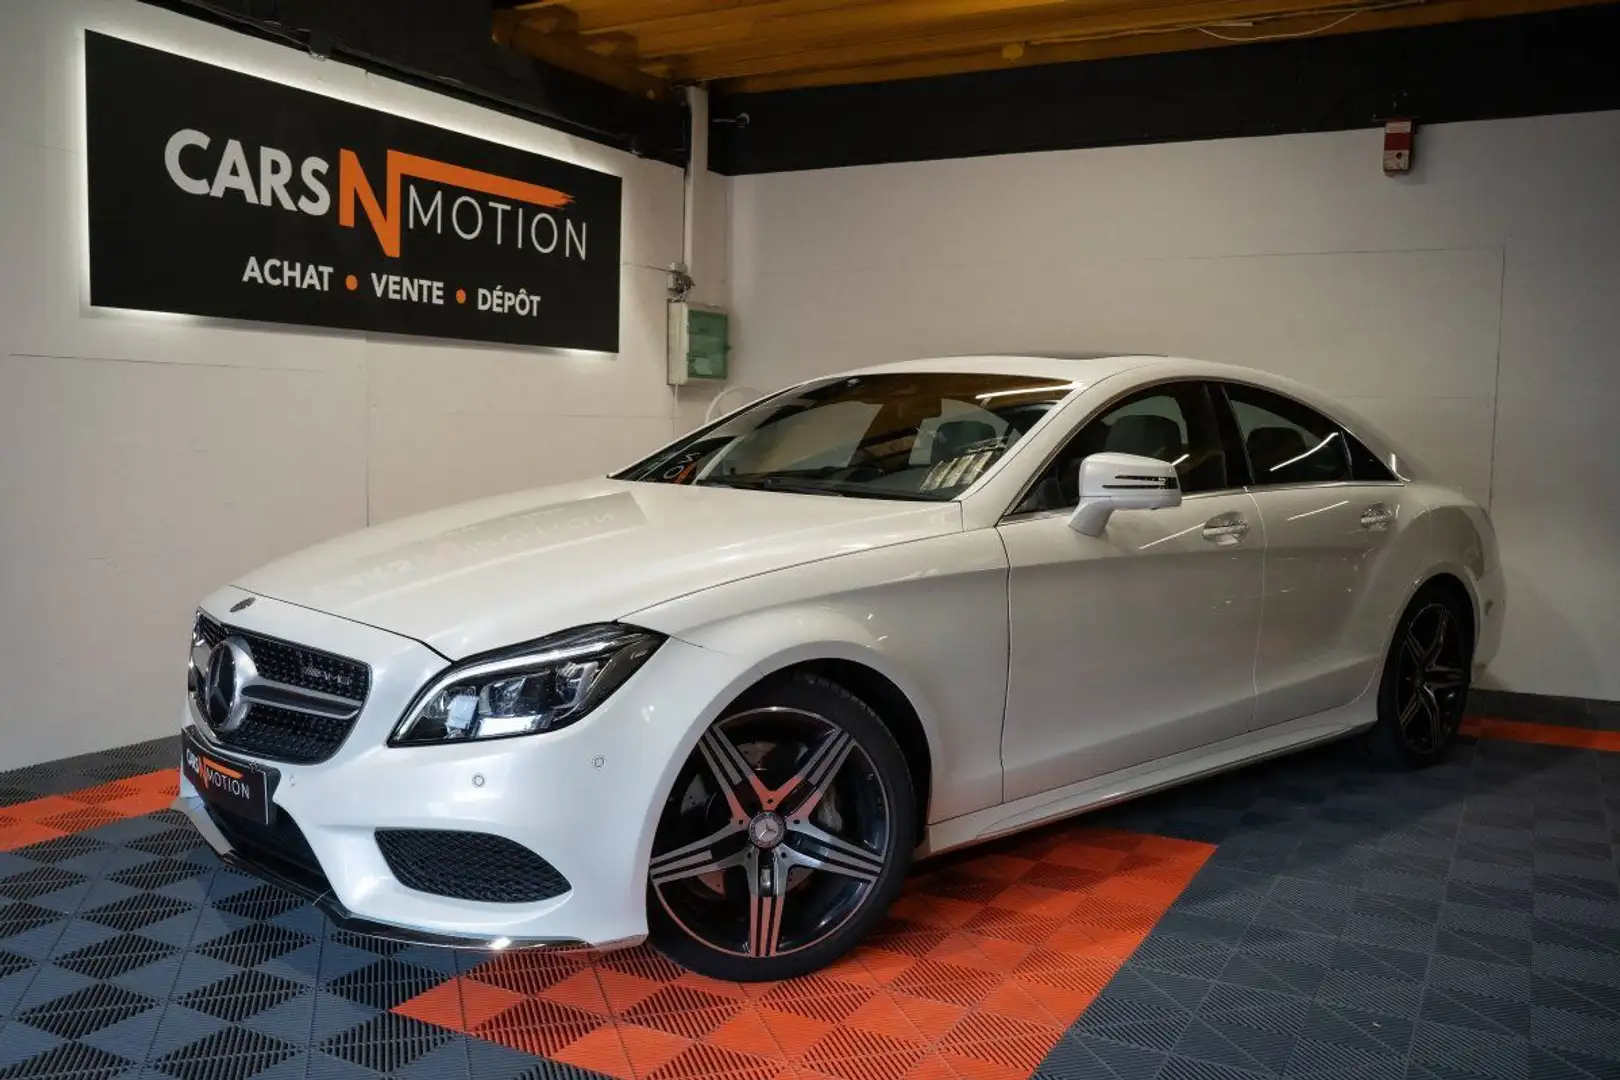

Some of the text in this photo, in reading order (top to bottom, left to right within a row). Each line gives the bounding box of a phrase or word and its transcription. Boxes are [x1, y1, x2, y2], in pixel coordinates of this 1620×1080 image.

[164, 128, 331, 216] CARS
[408, 184, 587, 261] MOTION
[241, 256, 542, 318] ACHAT VENTE DÉPÔT
